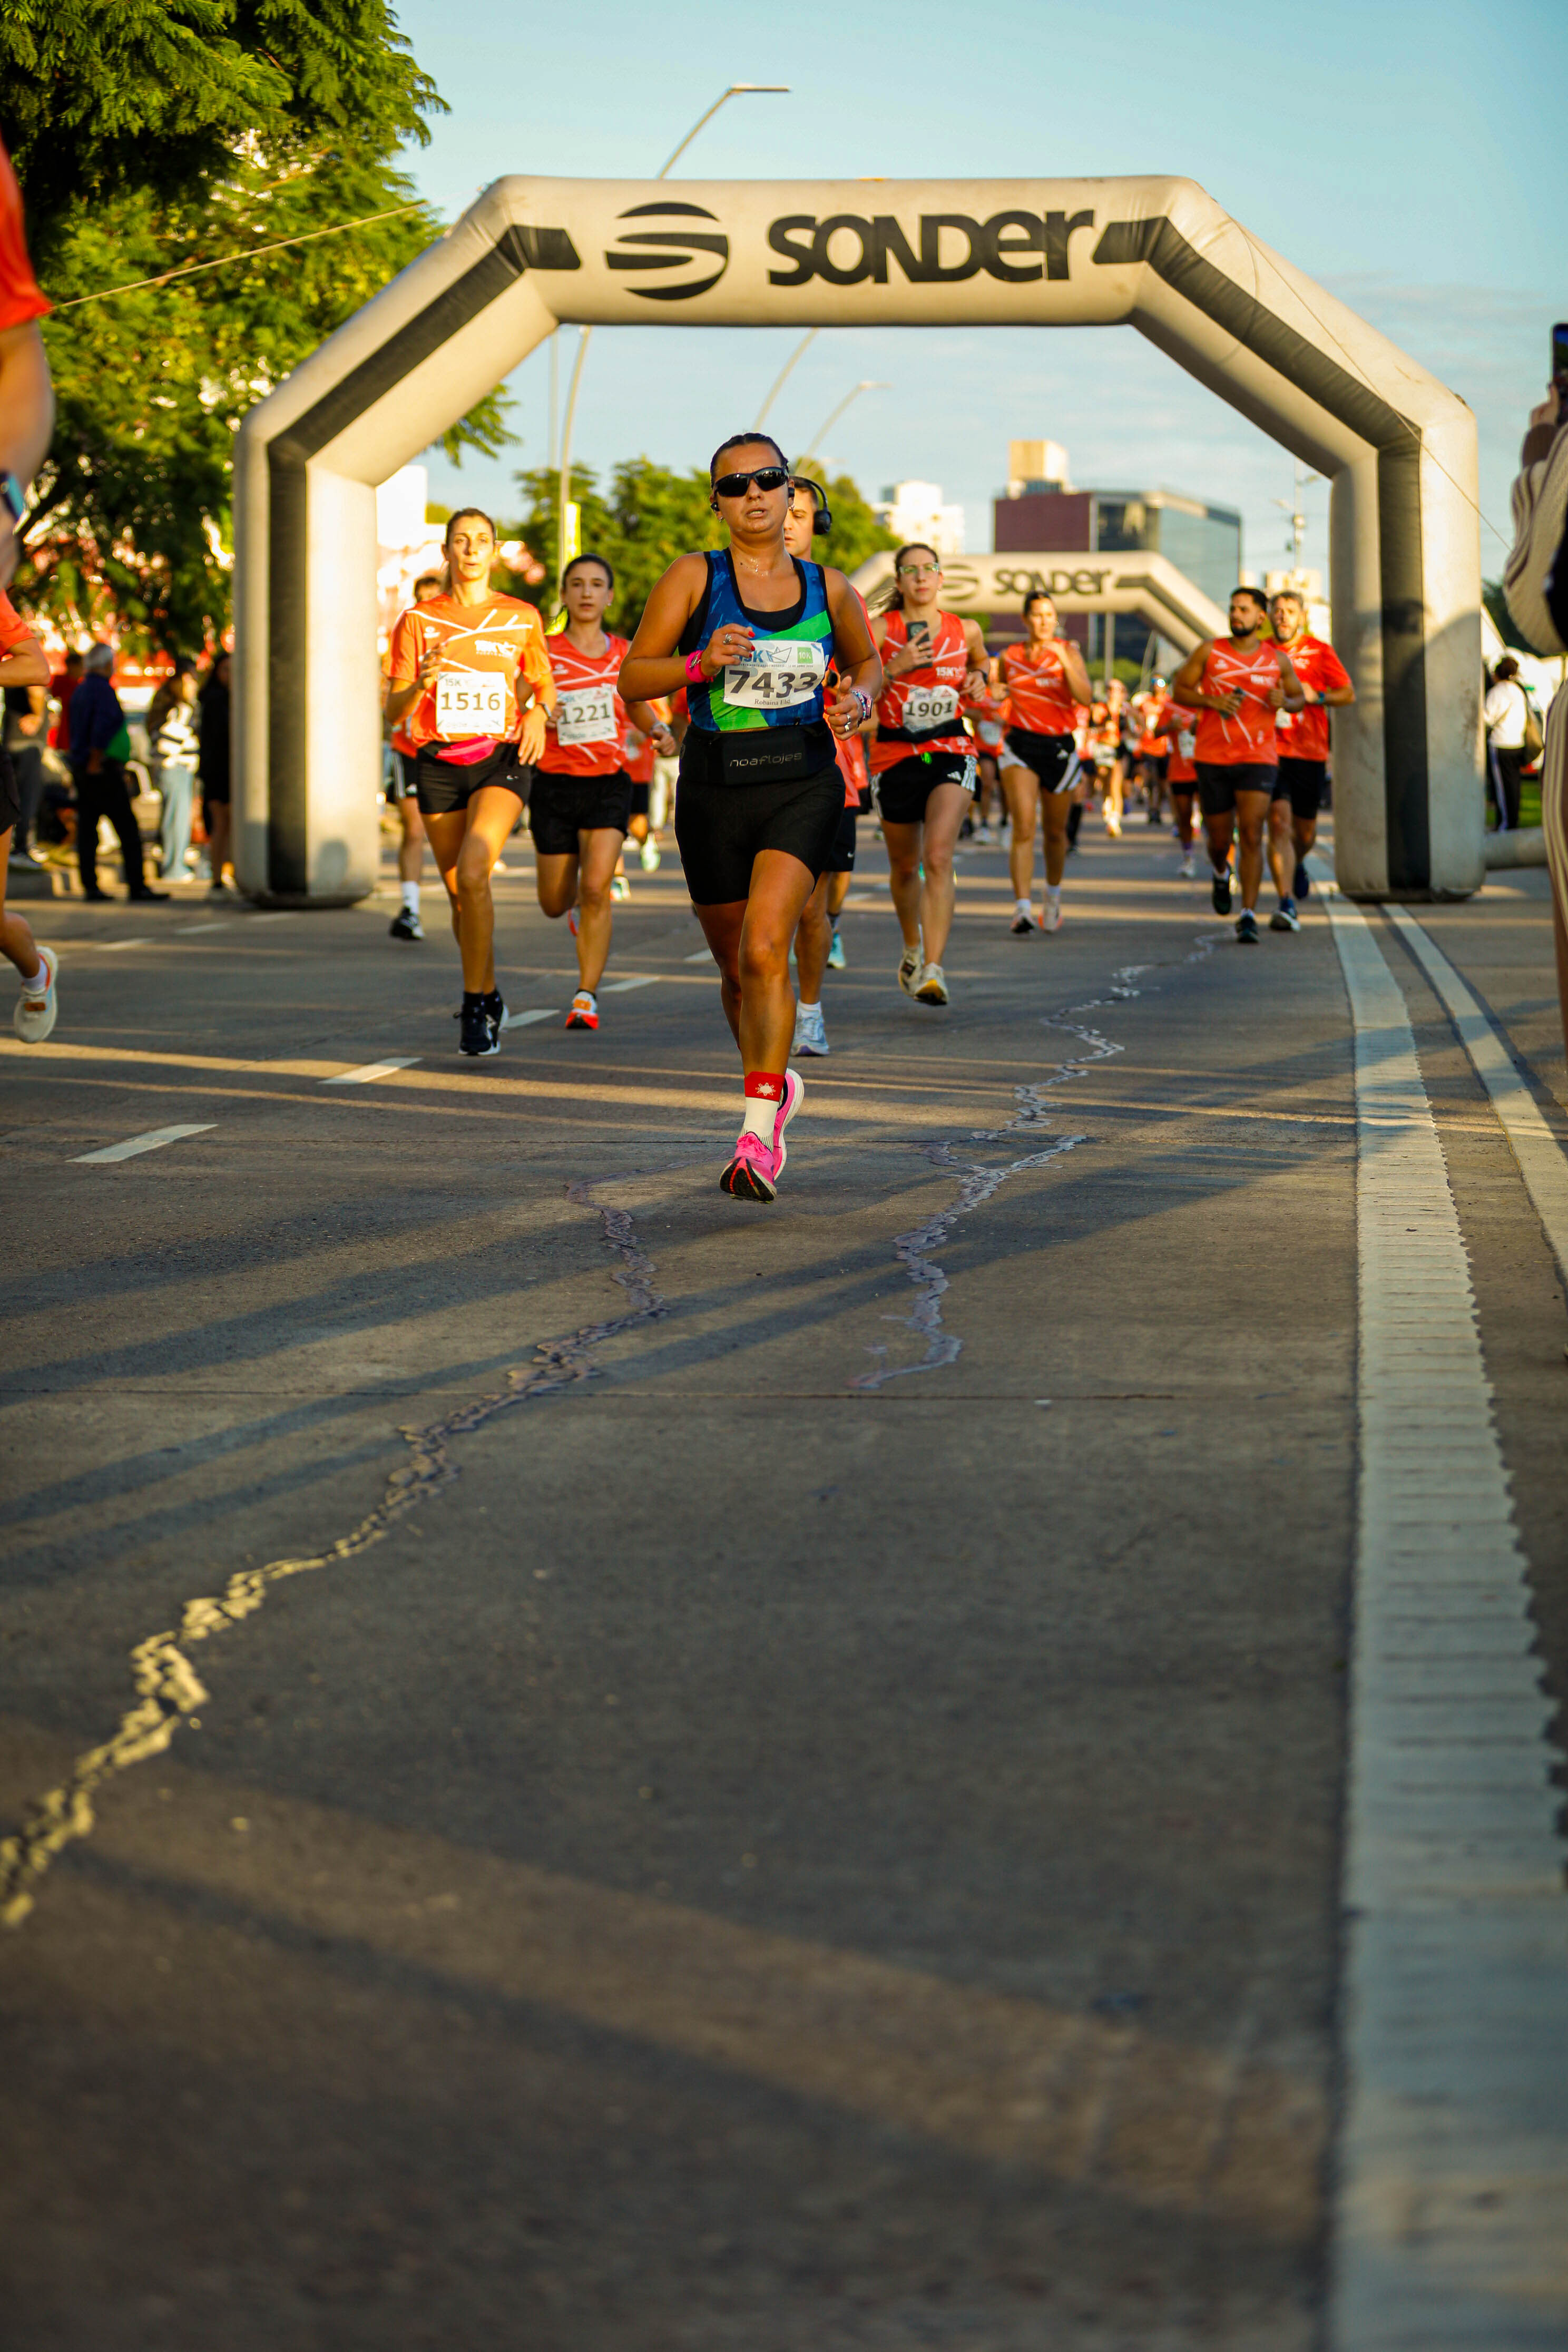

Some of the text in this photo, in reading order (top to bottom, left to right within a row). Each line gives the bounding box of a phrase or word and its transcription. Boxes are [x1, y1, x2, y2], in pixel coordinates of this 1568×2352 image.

[729, 669, 818, 698] 7433
[440, 692, 501, 711] 1516
[905, 700, 953, 717] 1901
[560, 702, 610, 724] 1221
[729, 752, 802, 767] noaflojes
